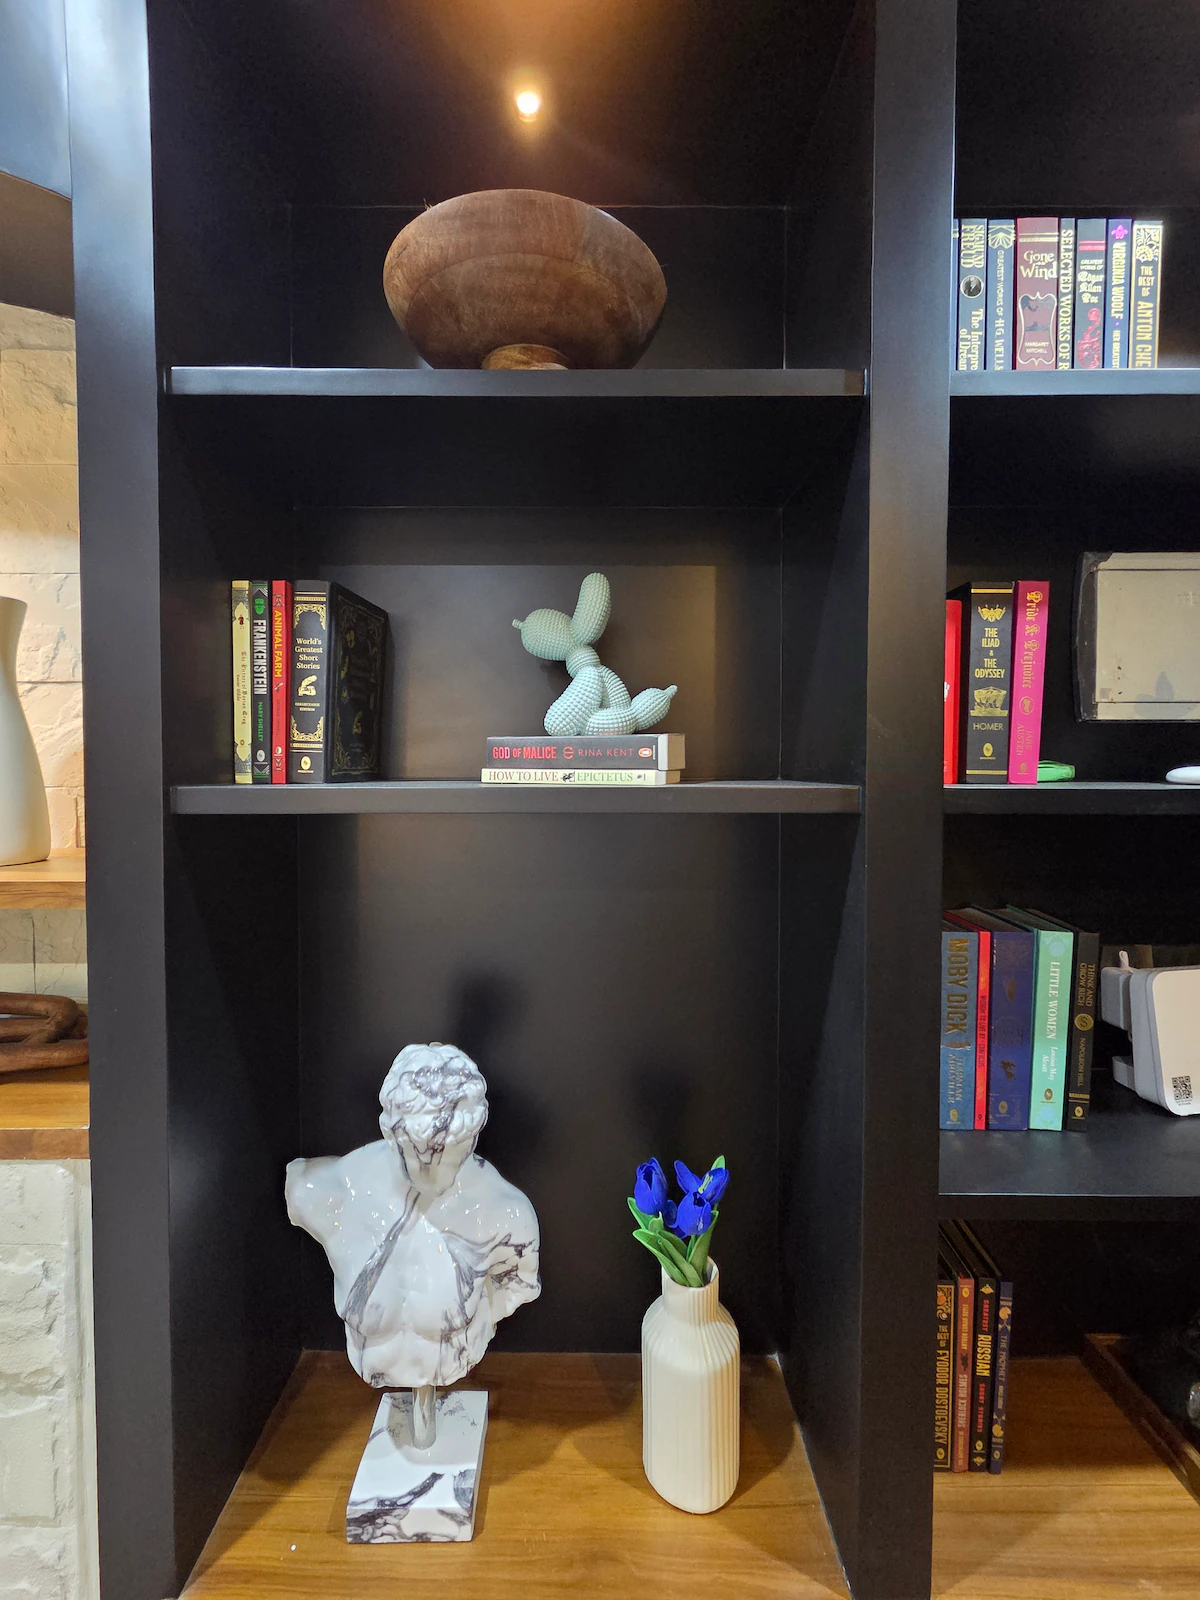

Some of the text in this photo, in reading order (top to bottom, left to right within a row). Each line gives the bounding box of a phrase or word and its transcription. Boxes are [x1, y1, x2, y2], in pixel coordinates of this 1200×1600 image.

[961, 224, 976, 268] FREUD
[974, 224, 985, 268] SIGMUND
[1023, 250, 1055, 264] Gone
[1060, 229, 1074, 293] SELECTED
[996, 250, 1005, 281] GREATEST
[1020, 261, 1058, 280] Wind
[1111, 242, 1126, 319] VIRGINIA WOOLF
[1140, 266, 1153, 276] THE
[996, 282, 1004, 306] WORKS
[1138, 276, 1155, 286] BEST
[971, 308, 983, 329] The
[996, 307, 1004, 317] OF
[1059, 294, 1072, 342] WORKS
[960, 328, 971, 340] of
[1135, 301, 1154, 368] ANTON CHE
[994, 340, 1005, 371] WELLS
[1058, 342, 1070, 360] OF
[1025, 590, 1043, 622] Pride
[274, 610, 283, 678] ANIMAL FARM
[296, 637, 322, 645] World's
[981, 638, 1000, 648] ILIAD
[984, 628, 998, 638] THE
[253, 619, 267, 695] FRANKENSTEIN
[983, 658, 997, 668] THE
[989, 649, 994, 657] &
[1020, 639, 1040, 688] Prejudice
[974, 668, 1006, 678] ODYSSEY
[973, 722, 1004, 731] HOMER
[1016, 723, 1025, 756] AUSTEN
[492, 746, 634, 759] GOD OF MALICE RINA KENT
[488, 771, 634, 782] HOW TO LIVE EPICTETUS
[945, 938, 969, 1035] MOBY DICK
[1077, 962, 1087, 1006] GROW RICH
[1085, 963, 1096, 1007] THINK AND
[1046, 961, 1060, 1039] LITTLE WOMEN
[1041, 1054, 1049, 1073] Alcott
[1048, 1046, 1058, 1080] Louisa May
[1078, 1037, 1086, 1072] NAPOLEON
[1000, 1335, 1008, 1348] THE
[976, 1299, 992, 1432] GREATEST RUSSIAN SHORT STORIES
[998, 1351, 1007, 1382] PROPHET
[934, 1350, 949, 1444] FYODOR DOSTOEVSKY
[958, 1374, 967, 1397] HOLMES
[957, 1398, 967, 1428] SHERLOCK
